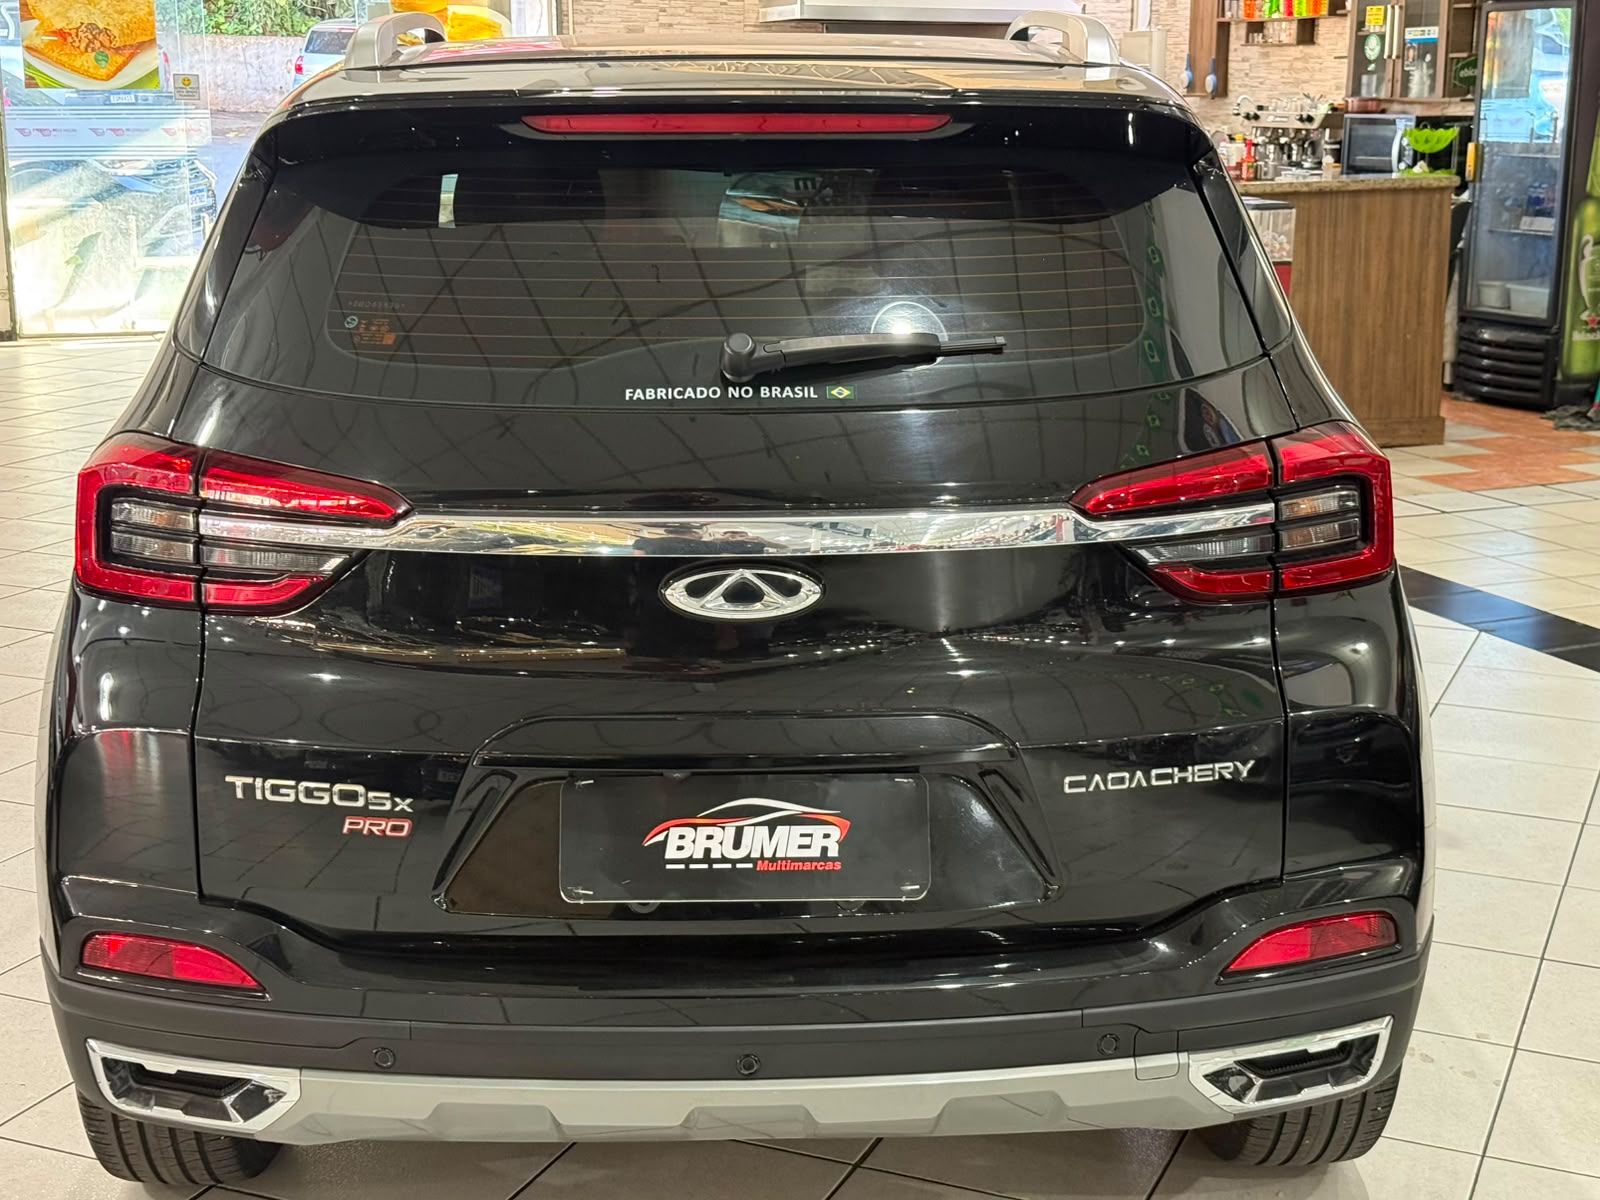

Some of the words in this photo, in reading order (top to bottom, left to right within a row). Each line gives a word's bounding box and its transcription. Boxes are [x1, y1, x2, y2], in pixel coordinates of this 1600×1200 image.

[625, 387, 721, 400] FABRICADO
[728, 387, 754, 398] NO
[760, 386, 818, 398] BRASIL
[342, 816, 413, 837] PRO
[664, 825, 842, 859] BRUMER
[756, 860, 842, 871] Multimarcas
